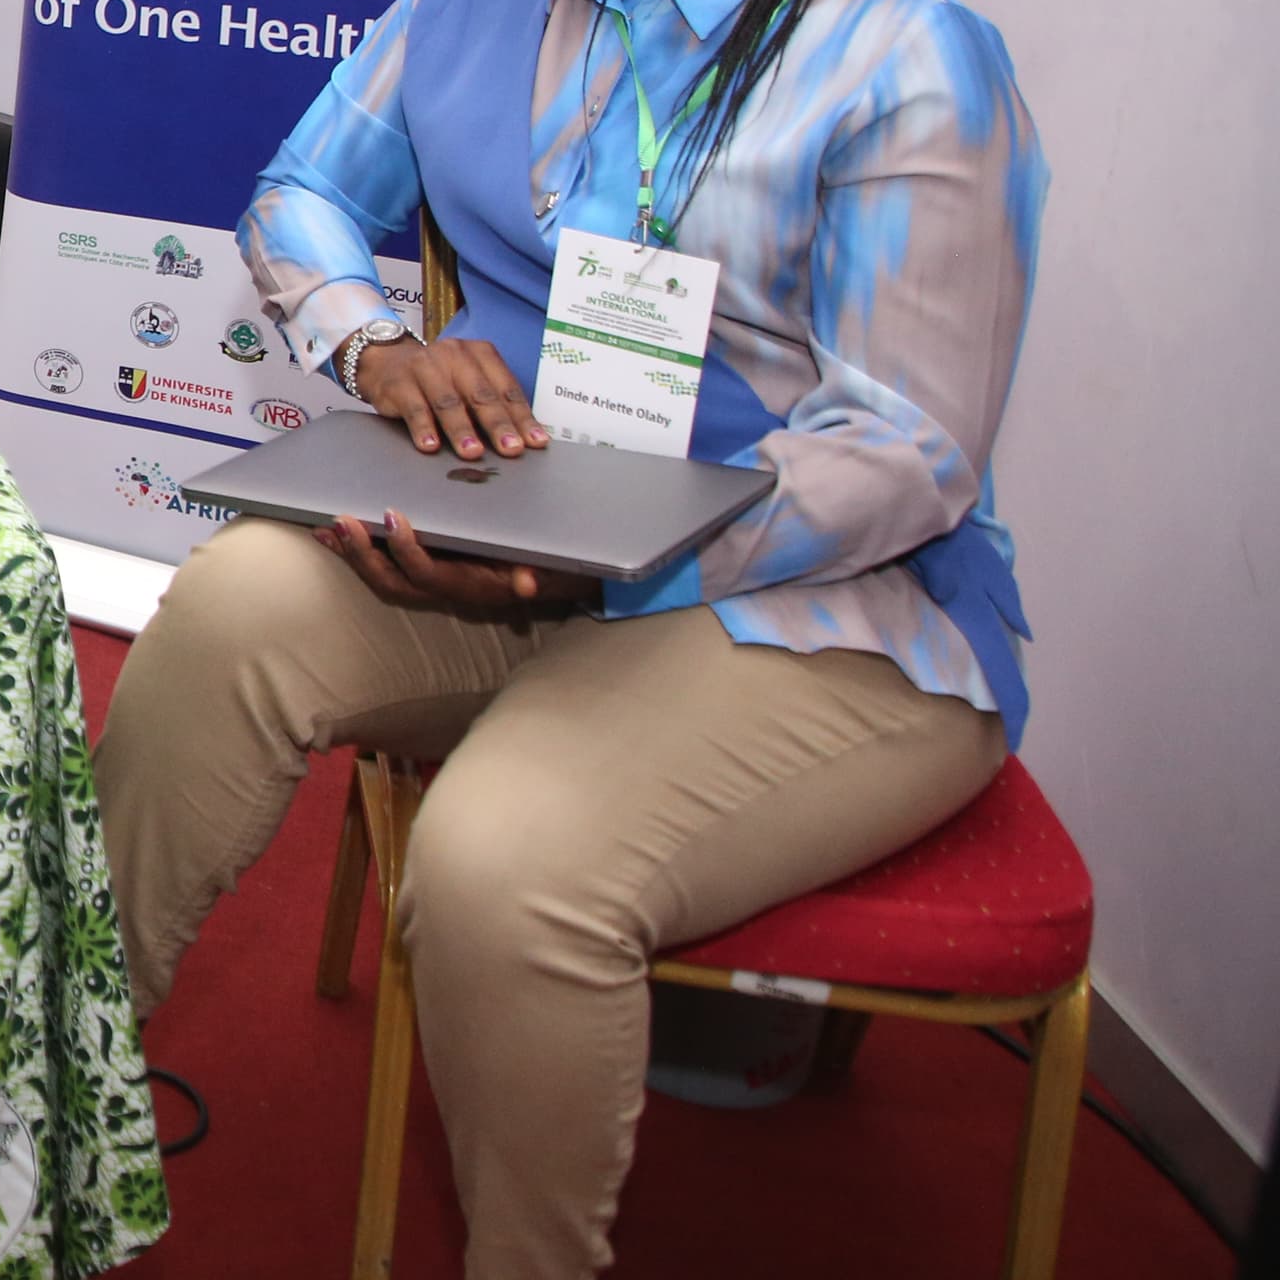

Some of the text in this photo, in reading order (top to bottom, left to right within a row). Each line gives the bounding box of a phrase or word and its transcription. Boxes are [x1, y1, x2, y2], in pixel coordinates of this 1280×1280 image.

[58, 232, 97, 248] CSRS
[585, 296, 668, 323] INTERNATIONAL
[600, 290, 657, 310] COLLOQUE
[152, 376, 234, 401] UNIVERSITE
[151, 391, 233, 416] DE KINSHASA
[554, 385, 671, 428] Dinde Arlette Olaby
[166, 495, 240, 522] AFRIC
